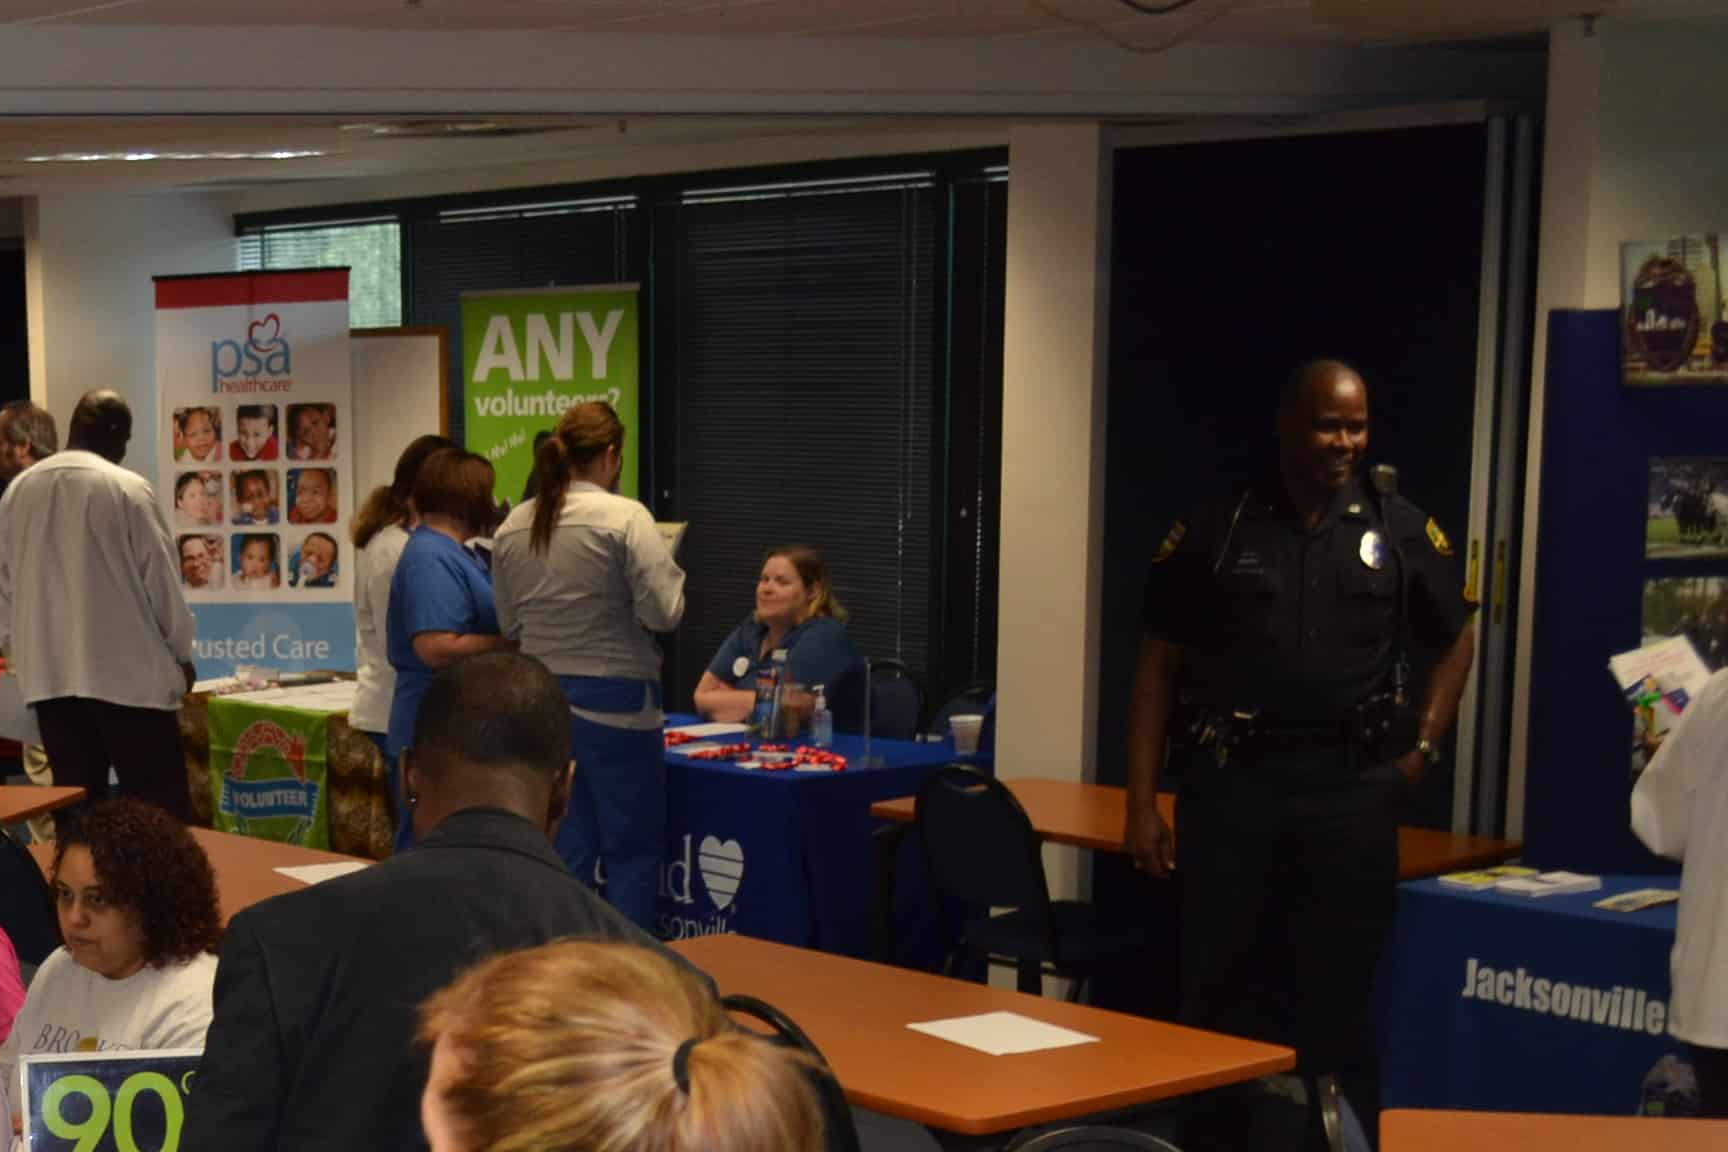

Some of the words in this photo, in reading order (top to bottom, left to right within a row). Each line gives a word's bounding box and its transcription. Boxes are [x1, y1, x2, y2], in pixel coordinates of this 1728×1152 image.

[211, 336, 290, 393] psa
[472, 309, 625, 384] ANY
[220, 379, 293, 393] healthcare
[192, 632, 266, 660] usted
[273, 634, 329, 660] Care
[1462, 957, 1667, 1036] Jacksonville
